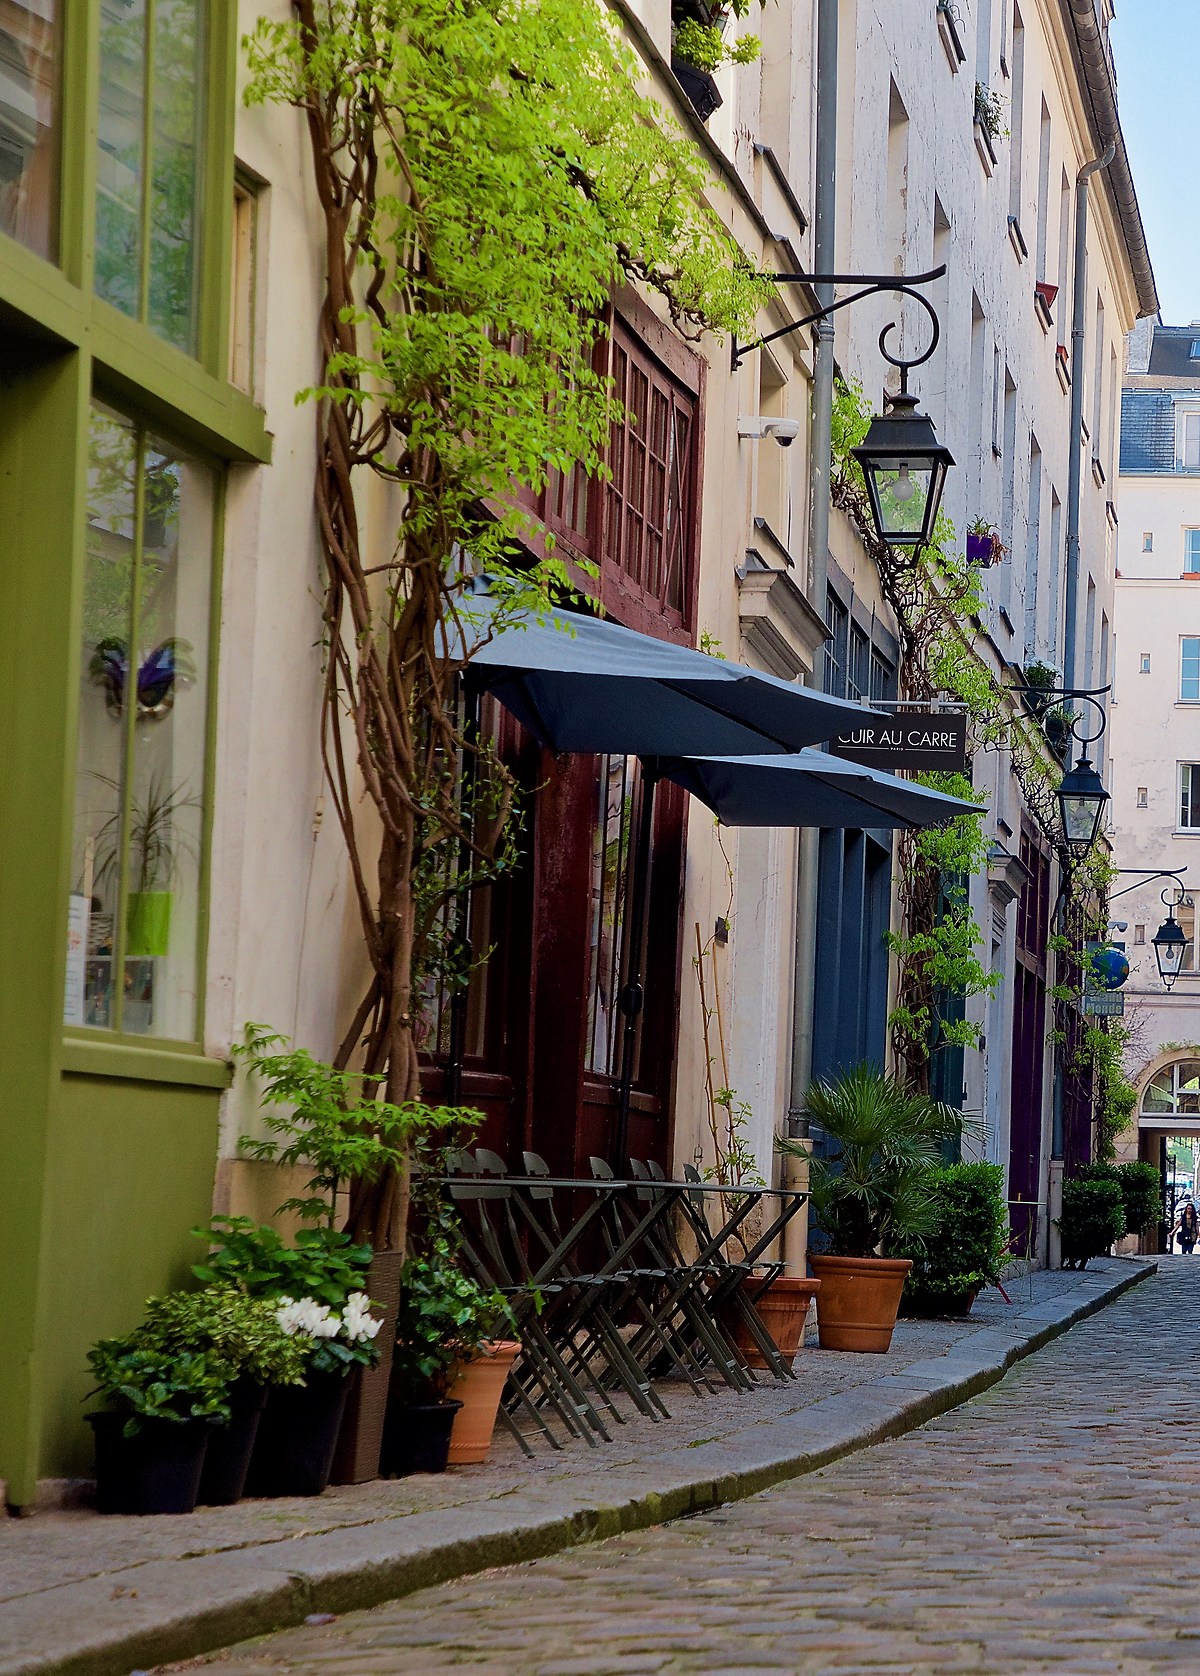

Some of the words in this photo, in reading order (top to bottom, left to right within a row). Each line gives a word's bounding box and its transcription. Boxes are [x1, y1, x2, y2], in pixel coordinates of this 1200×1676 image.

[879, 730, 902, 745] AU
[907, 731, 957, 748] CARRE
[1085, 1003, 1122, 1014] Monde
